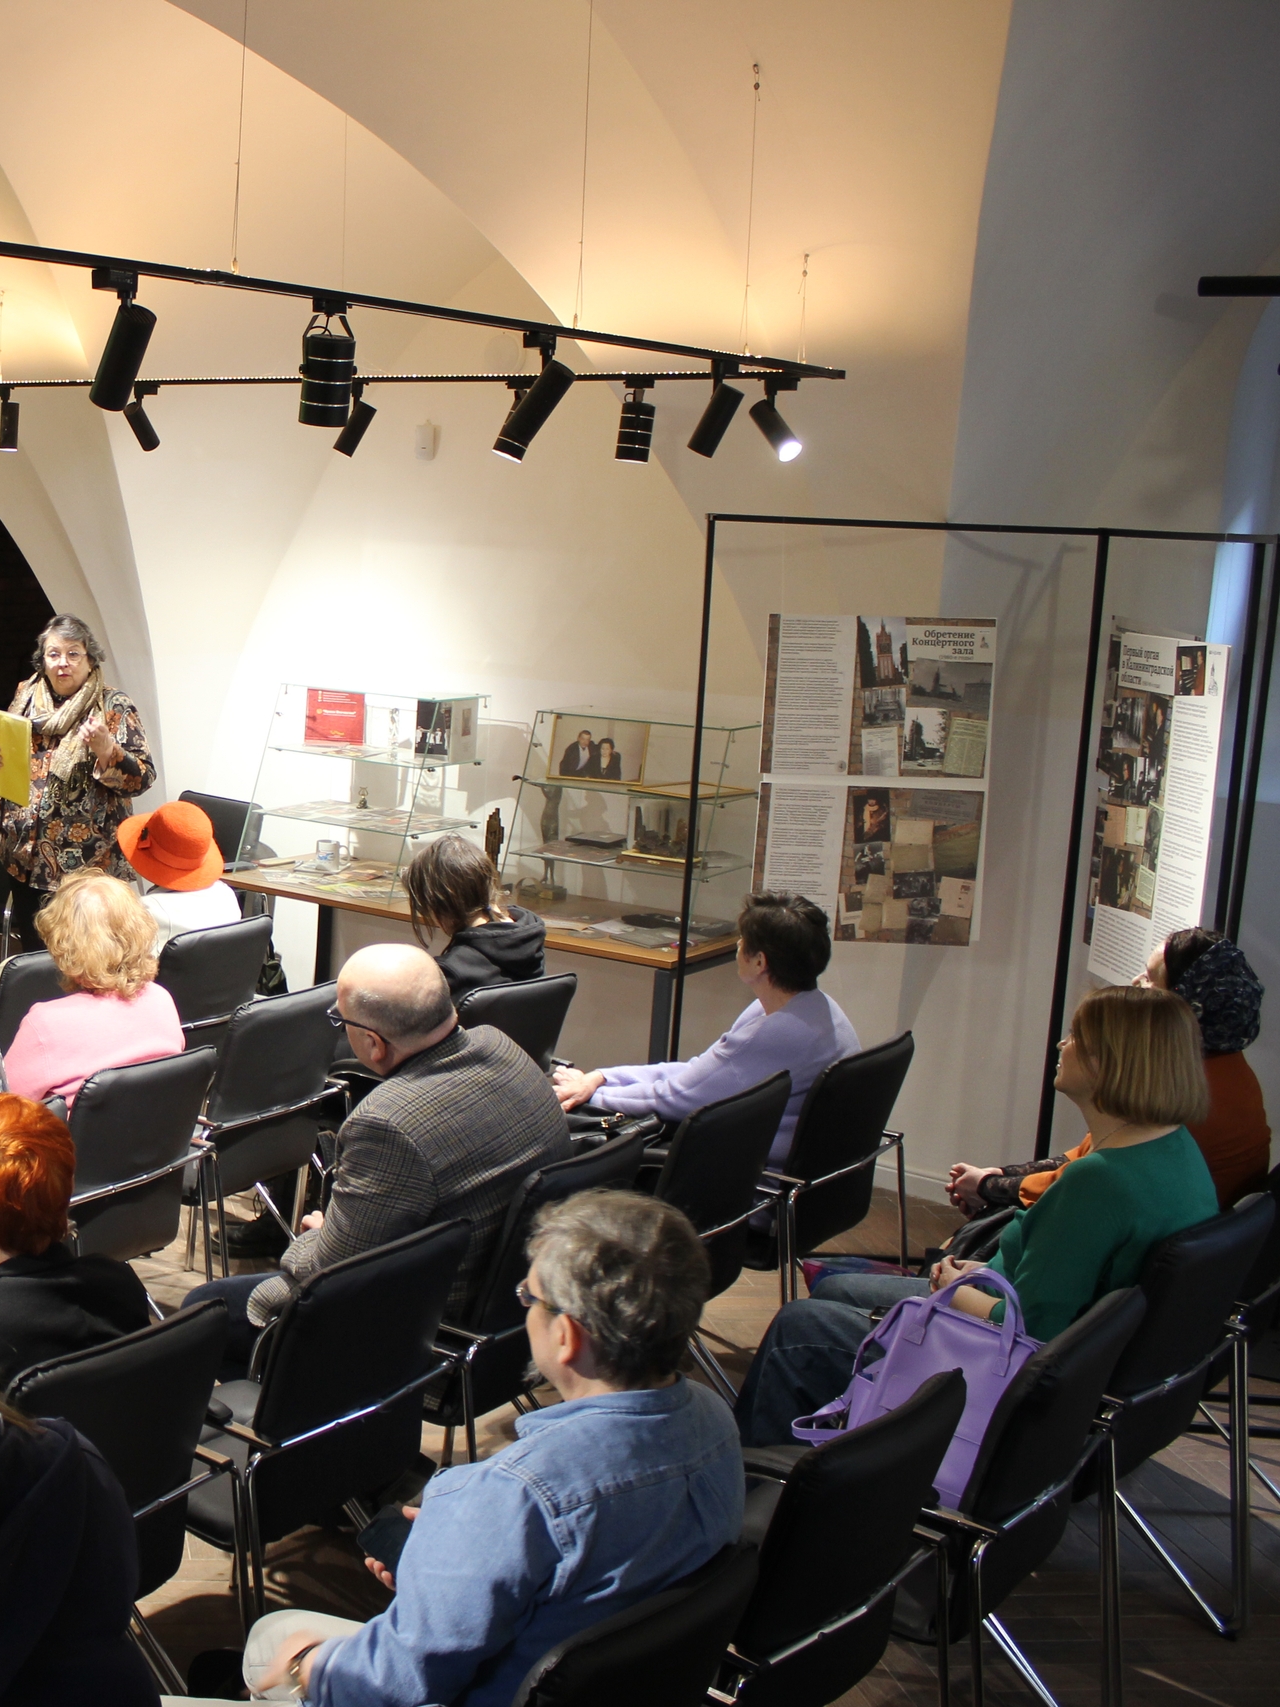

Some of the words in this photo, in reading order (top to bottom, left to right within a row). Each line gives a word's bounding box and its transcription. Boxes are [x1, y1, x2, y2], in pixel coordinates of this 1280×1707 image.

[924, 630, 975, 639] Обретение
[912, 638, 975, 648] Концертного
[1123, 645, 1143, 660] Первый
